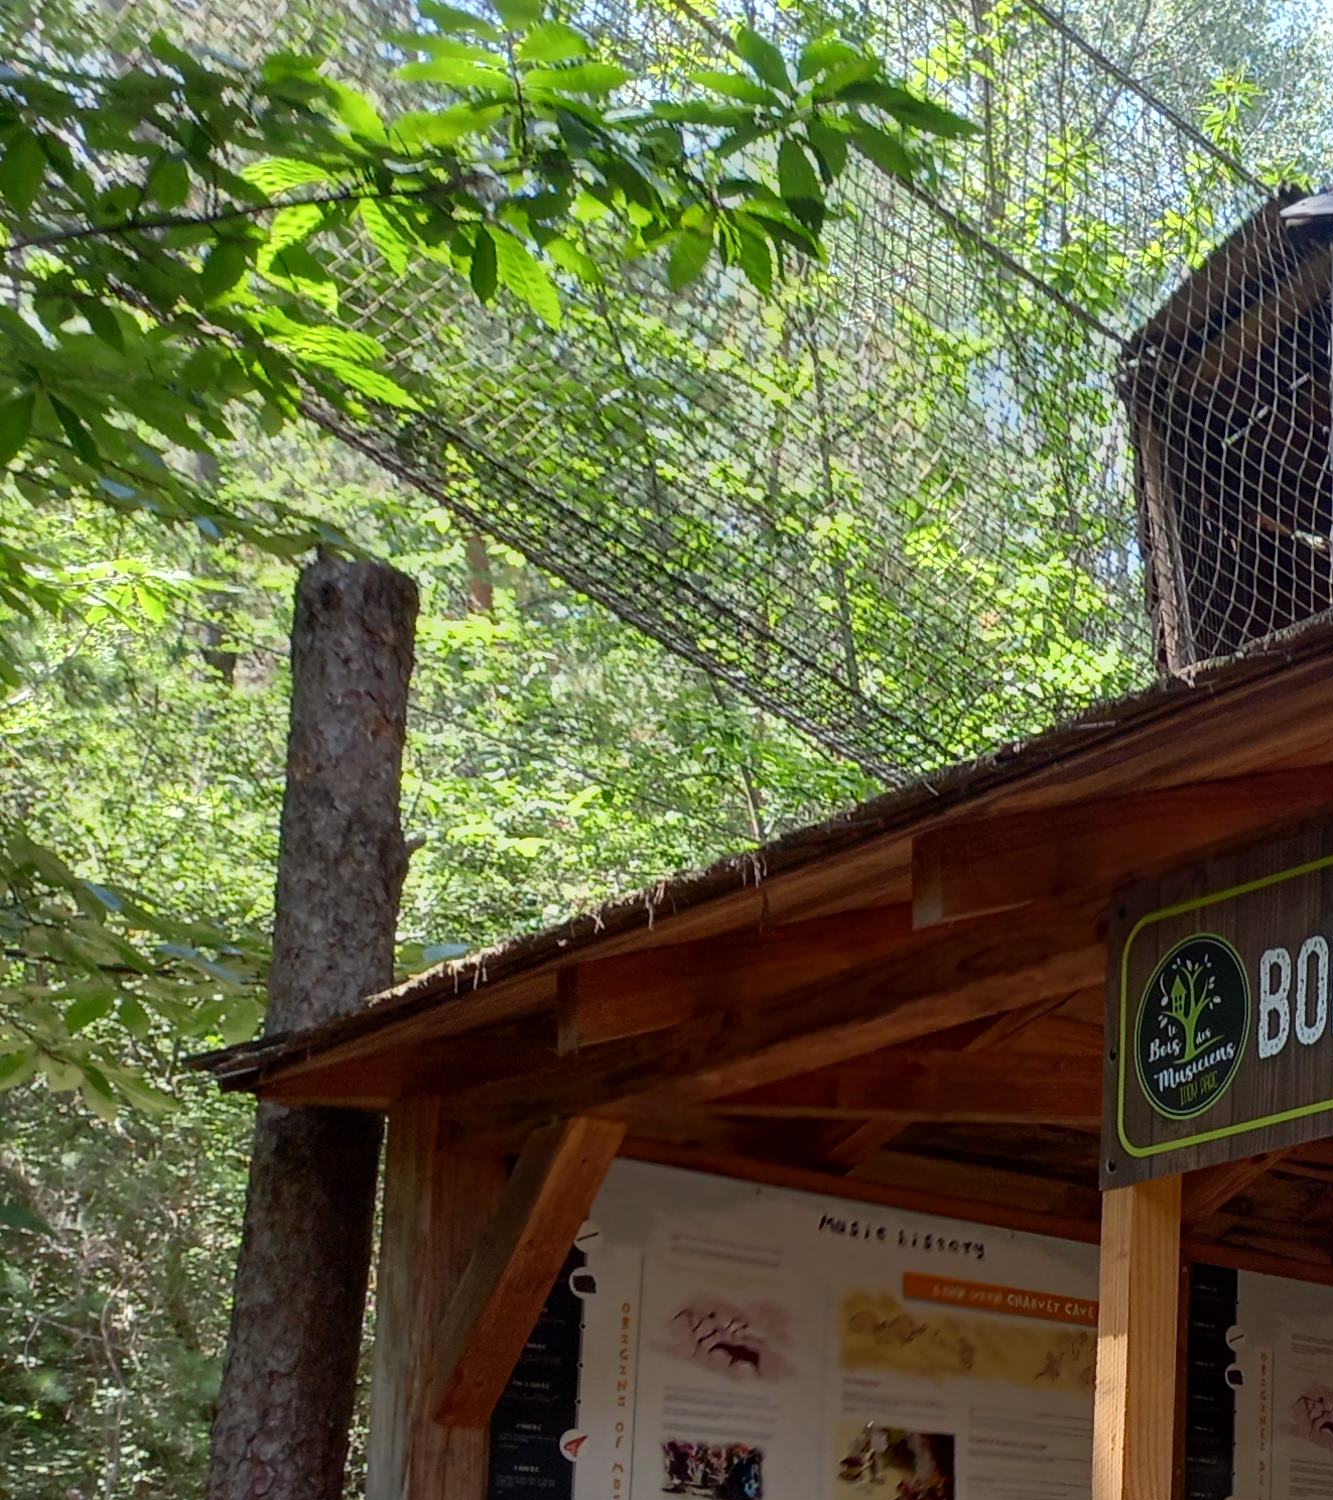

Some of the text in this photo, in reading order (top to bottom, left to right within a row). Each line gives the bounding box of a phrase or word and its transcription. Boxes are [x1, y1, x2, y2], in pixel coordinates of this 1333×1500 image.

[1147, 1037, 1183, 1063] Bois
[1153, 1041, 1238, 1093] Musiciens
[818, 1213, 887, 1241] Music
[1064, 1302, 1096, 1320] CAVE
